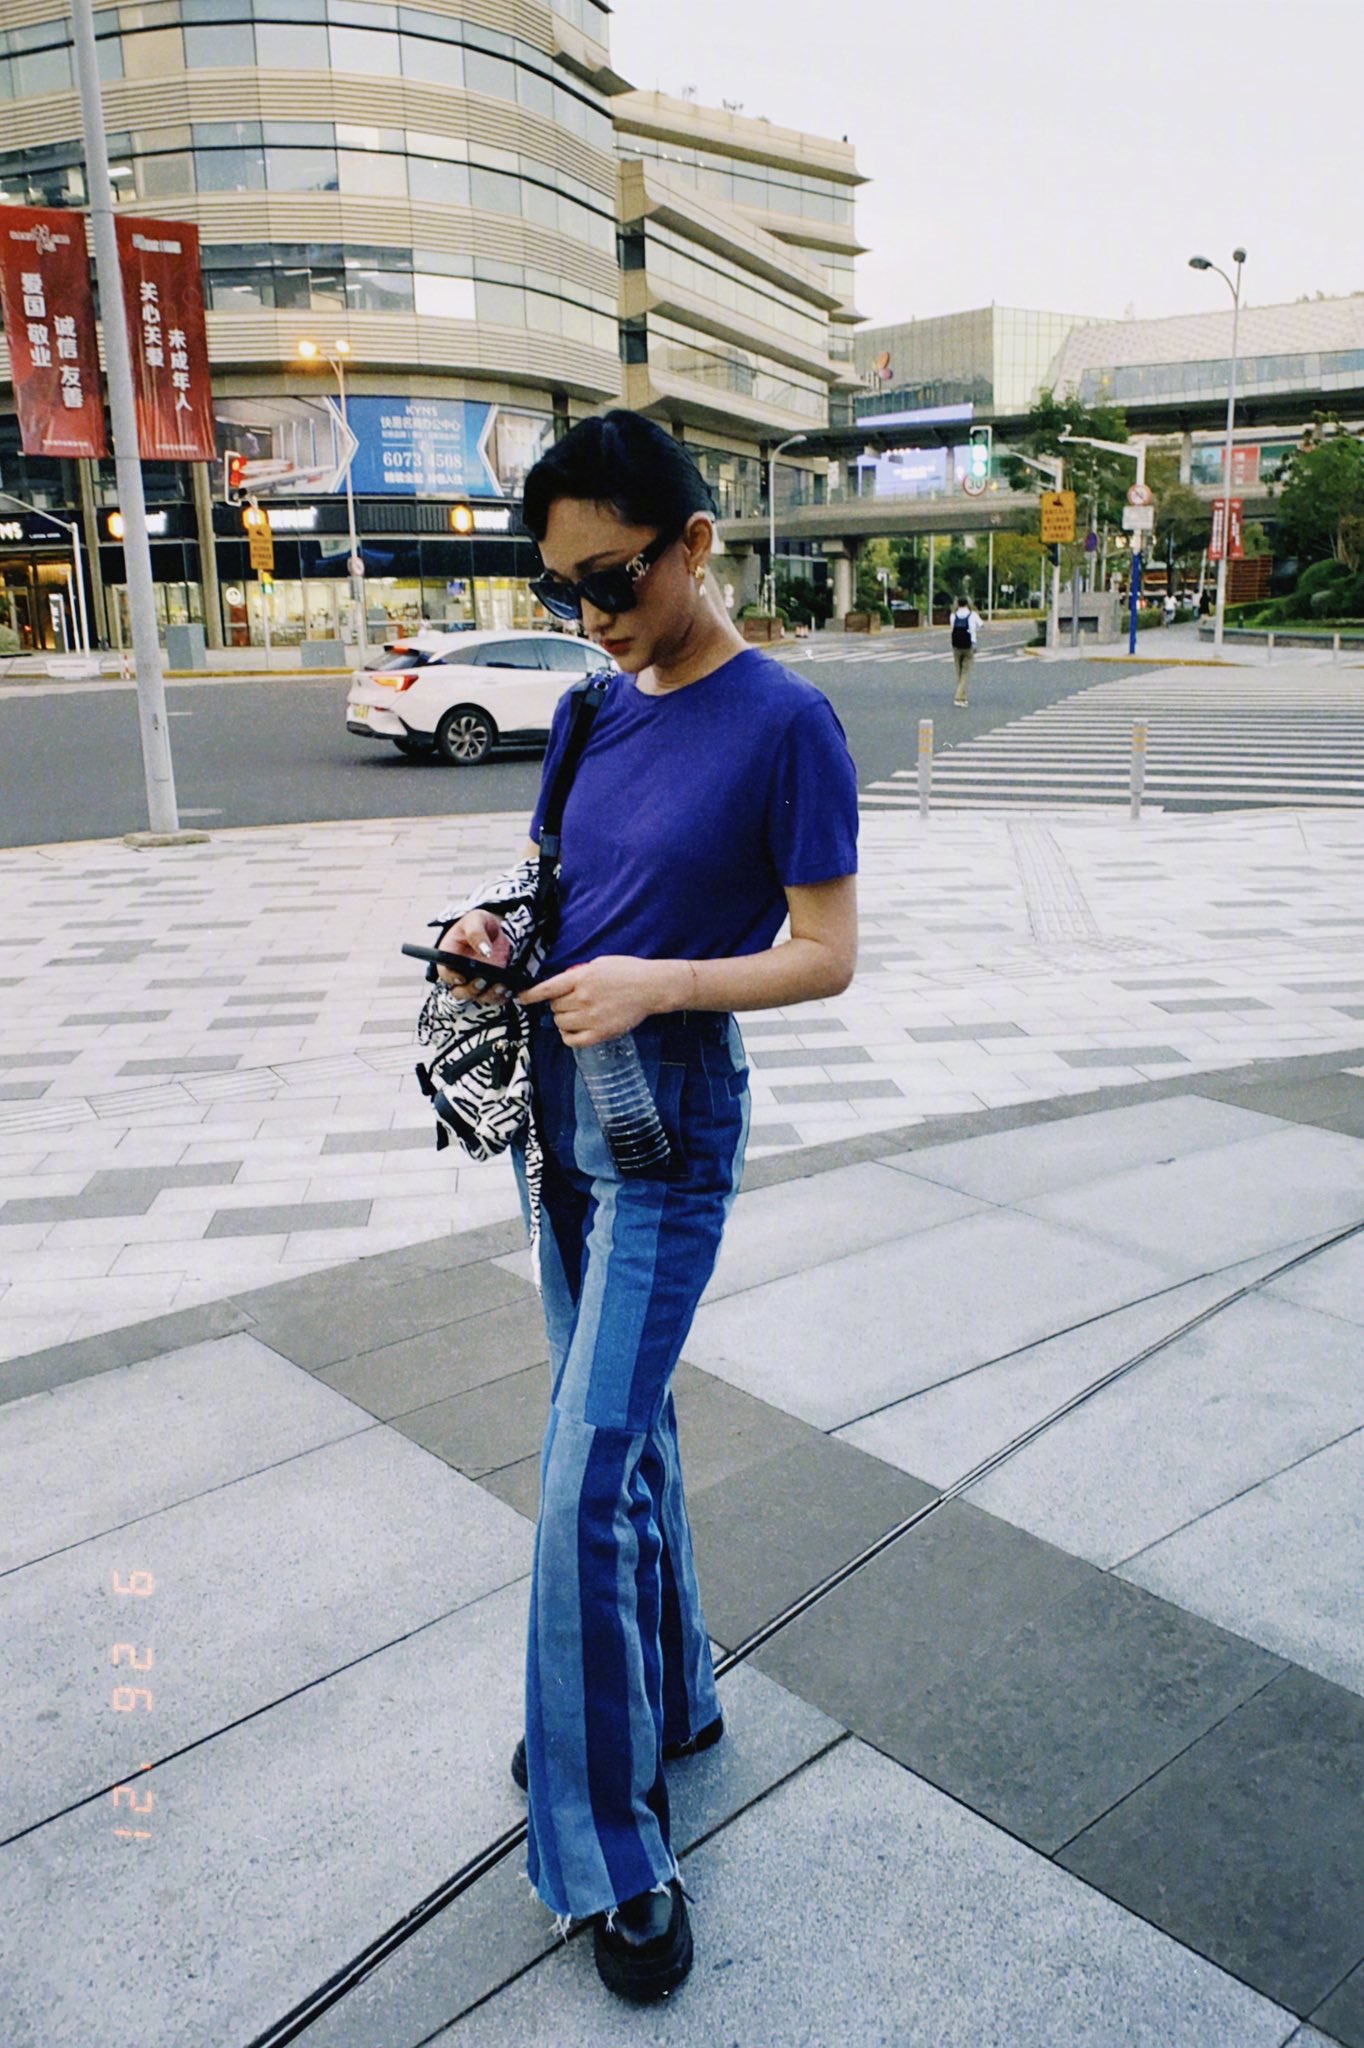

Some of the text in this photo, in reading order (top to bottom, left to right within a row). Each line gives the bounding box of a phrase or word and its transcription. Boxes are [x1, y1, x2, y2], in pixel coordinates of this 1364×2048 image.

[20, 272, 52, 368] 爱国敬业
[140, 281, 165, 368] 关心关爱
[168, 329, 193, 412] 未成年人
[382, 451, 422, 467] 6073
